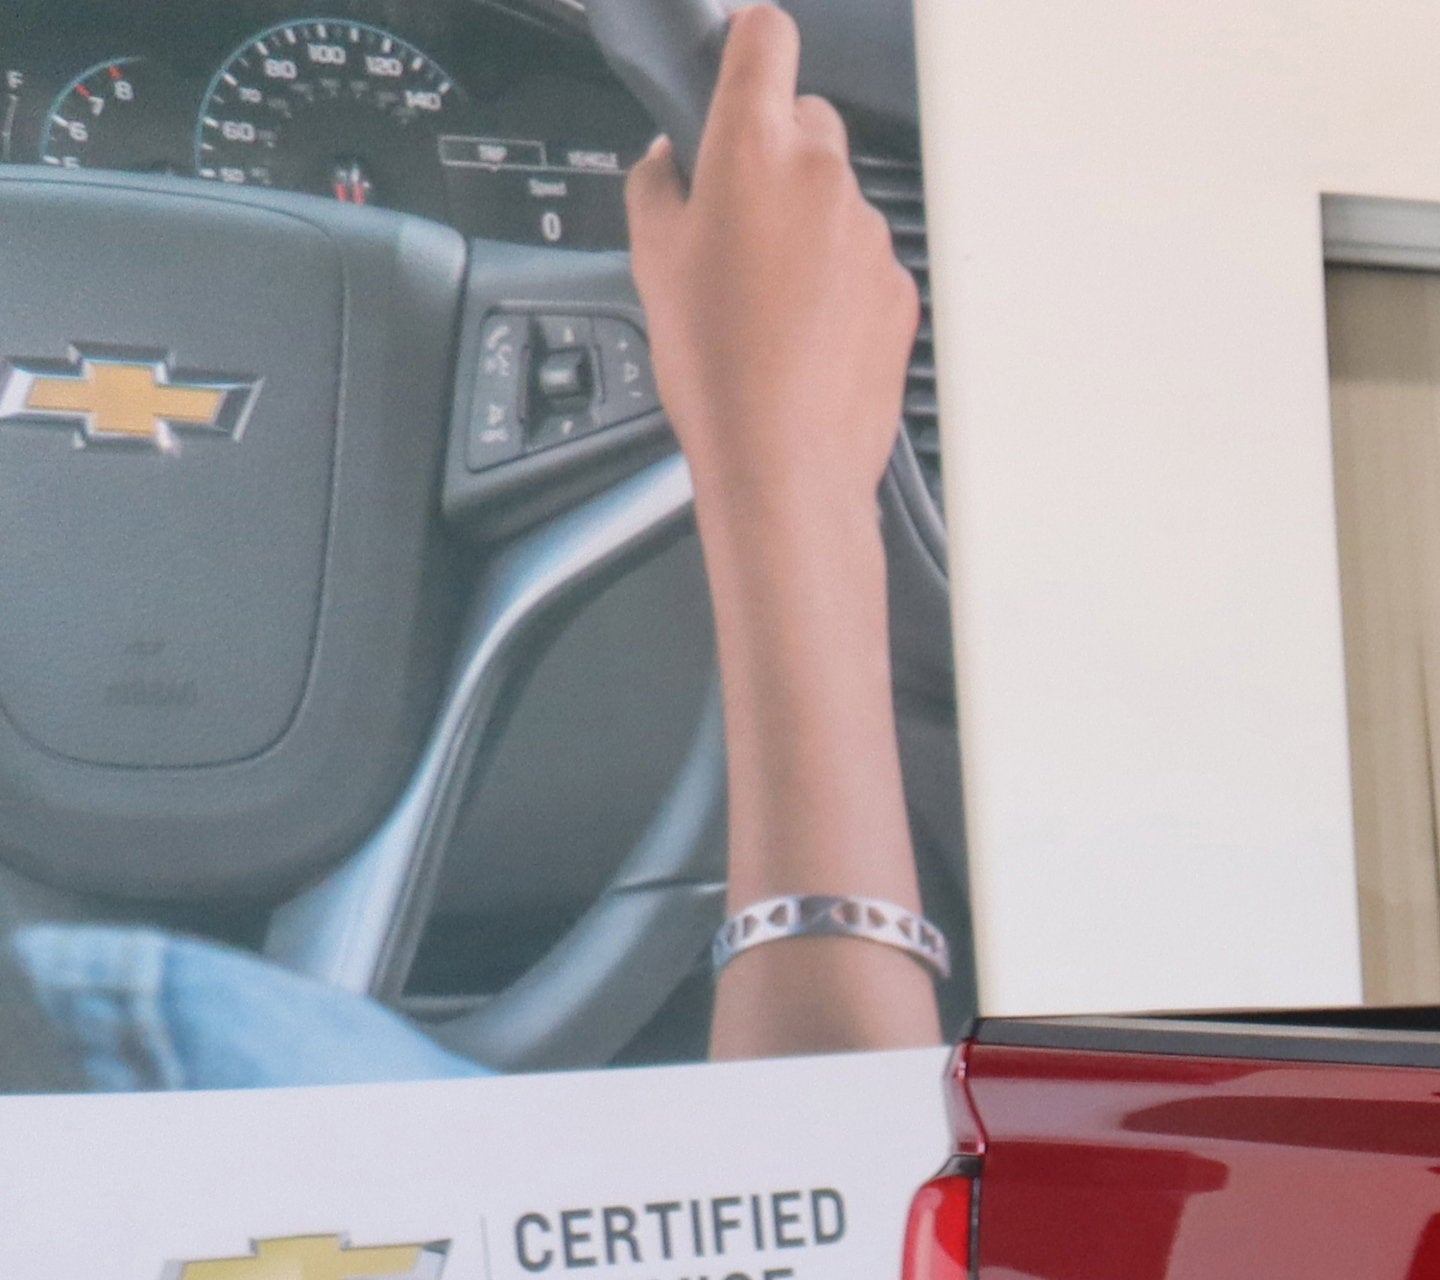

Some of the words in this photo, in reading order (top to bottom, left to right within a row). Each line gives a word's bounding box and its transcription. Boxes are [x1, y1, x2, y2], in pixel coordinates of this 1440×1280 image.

[308, 43, 347, 65] 100
[264, 58, 297, 79] 80
[366, 55, 402, 77] 120
[513, 1188, 848, 1273] CERTIFIED
